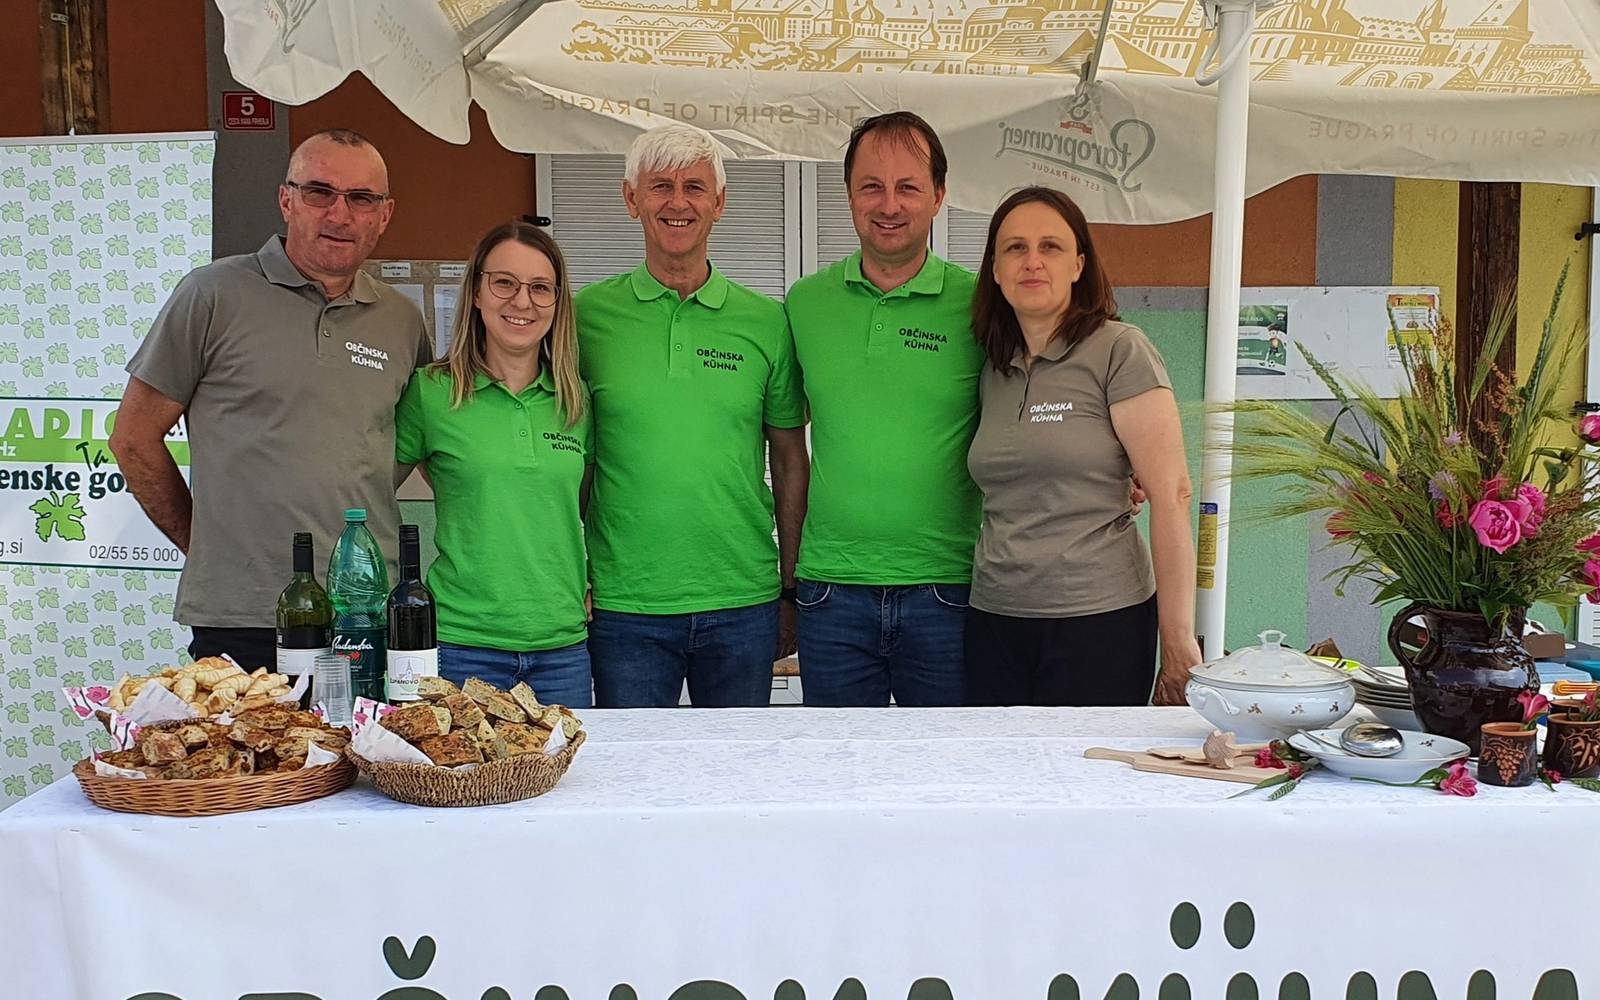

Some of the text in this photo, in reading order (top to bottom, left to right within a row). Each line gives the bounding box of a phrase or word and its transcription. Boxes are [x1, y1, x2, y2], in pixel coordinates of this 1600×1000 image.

[240, 96, 255, 116] 5
[898, 327, 948, 344] OBČINSKA
[345, 341, 389, 361] OBČINSKA
[696, 348, 745, 362] OBČINSKA
[1029, 401, 1073, 413] OBČINSKA
[88, 471, 133, 499] go
[89, 545, 179, 562] 02/55 55 000
[331, 634, 374, 654] Radenska
